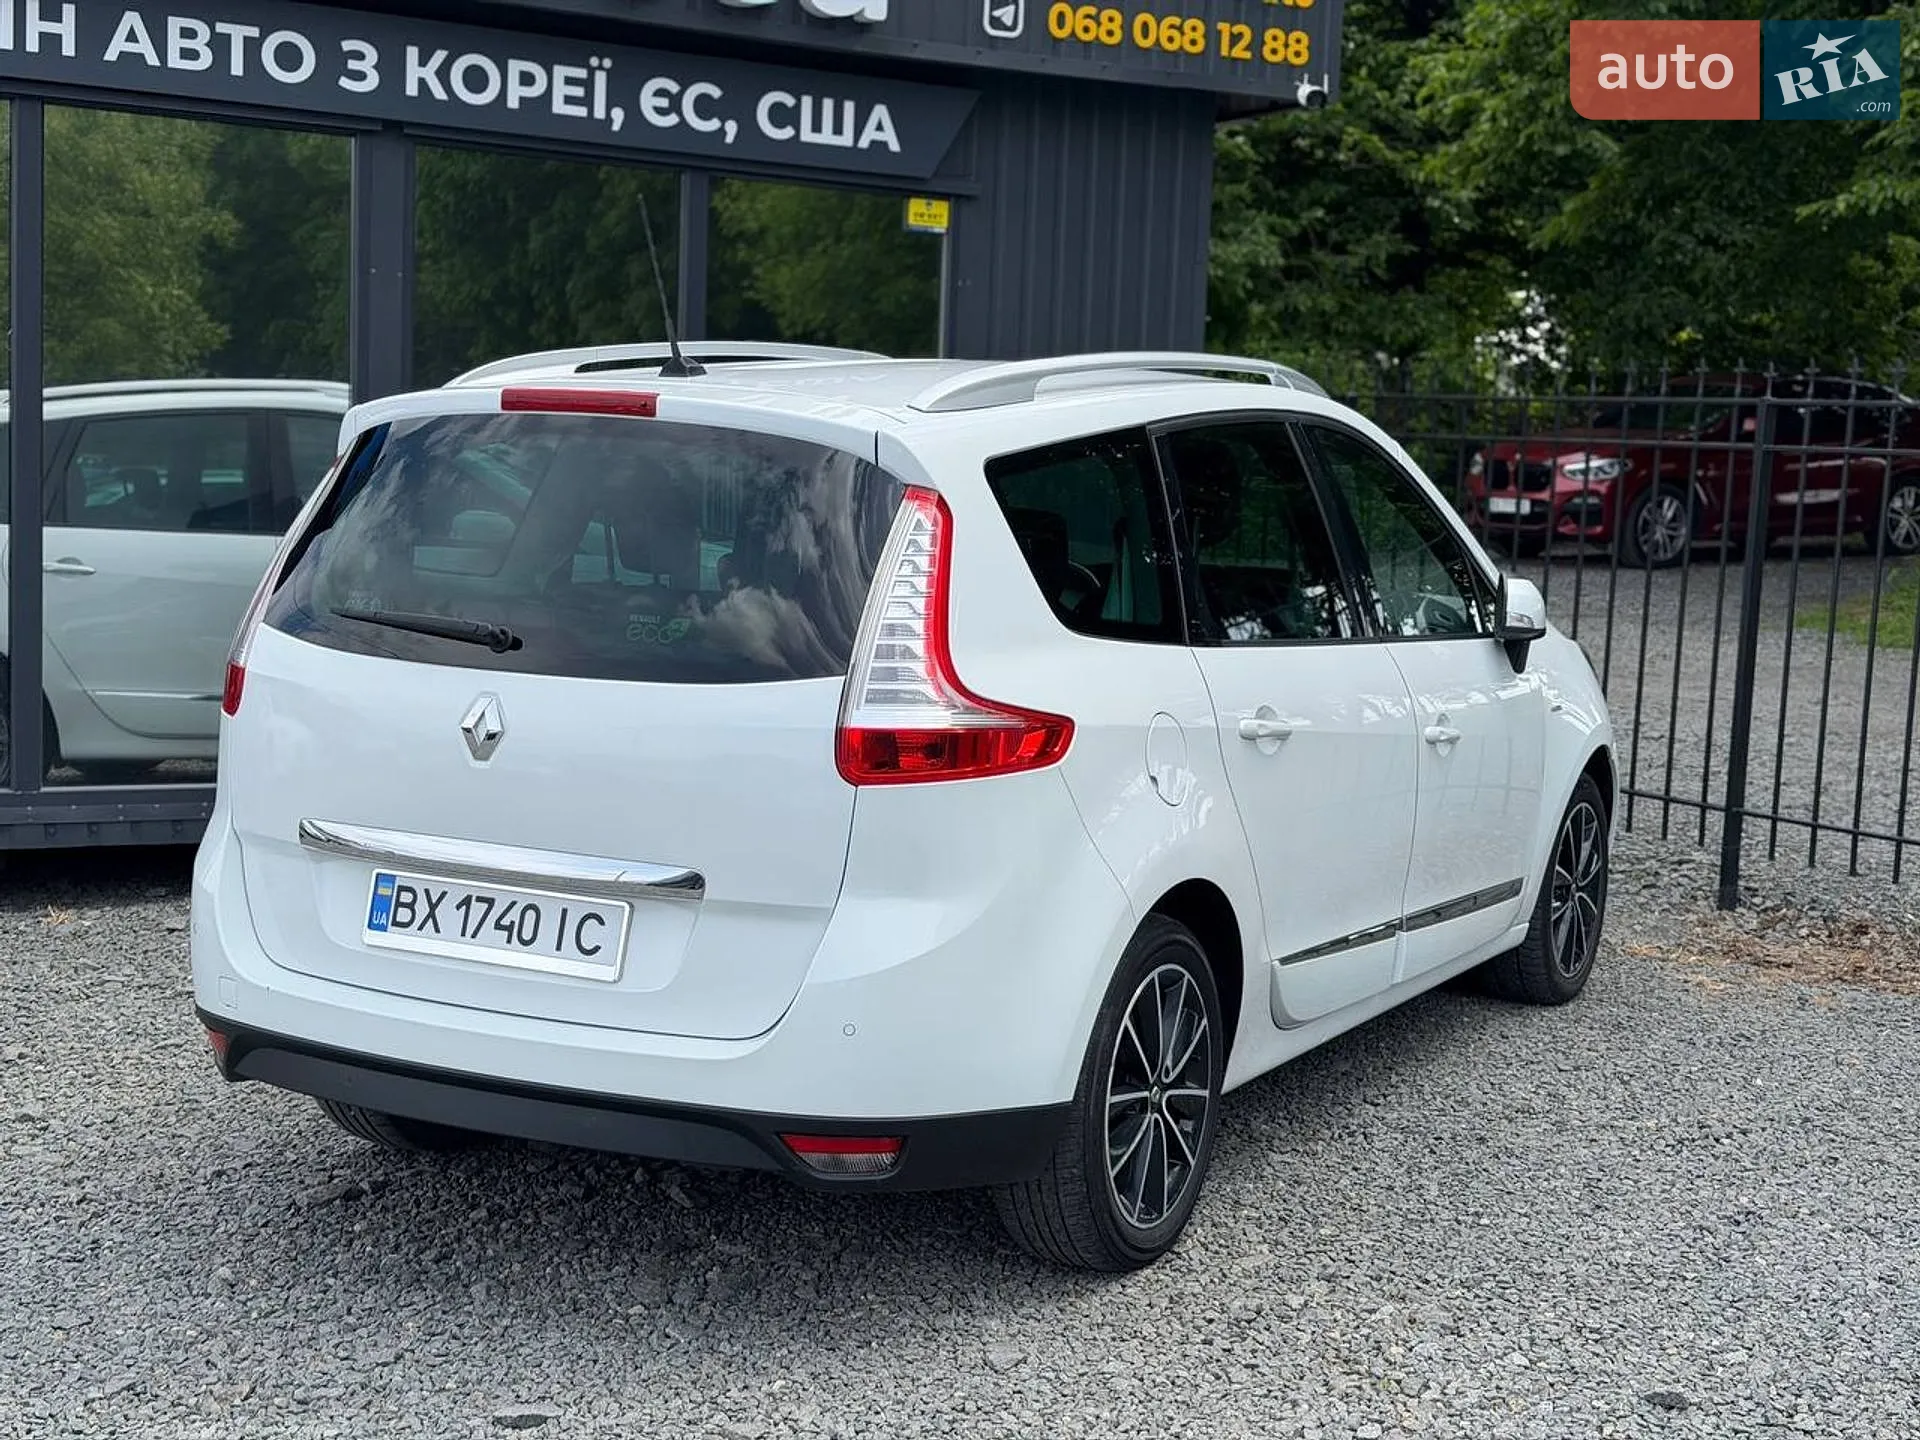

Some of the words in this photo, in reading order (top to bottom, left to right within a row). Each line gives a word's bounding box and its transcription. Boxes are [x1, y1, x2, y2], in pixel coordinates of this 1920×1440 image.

[1047, 2, 1123, 46] 068
[1131, 11, 1206, 55] 068
[1217, 21, 1253, 60] 12
[1262, 27, 1311, 66] 88
[103, 10, 316, 84] АВТО
[338, 39, 380, 92] З
[405, 46, 625, 132] КОРЕЇ,
[639, 77, 738, 144] ЄС,
[756, 91, 901, 153] США
[373, 911, 388, 926] UA
[391, 884, 448, 934] BX
[455, 894, 541, 947] 1740
[555, 907, 606, 957] IC
